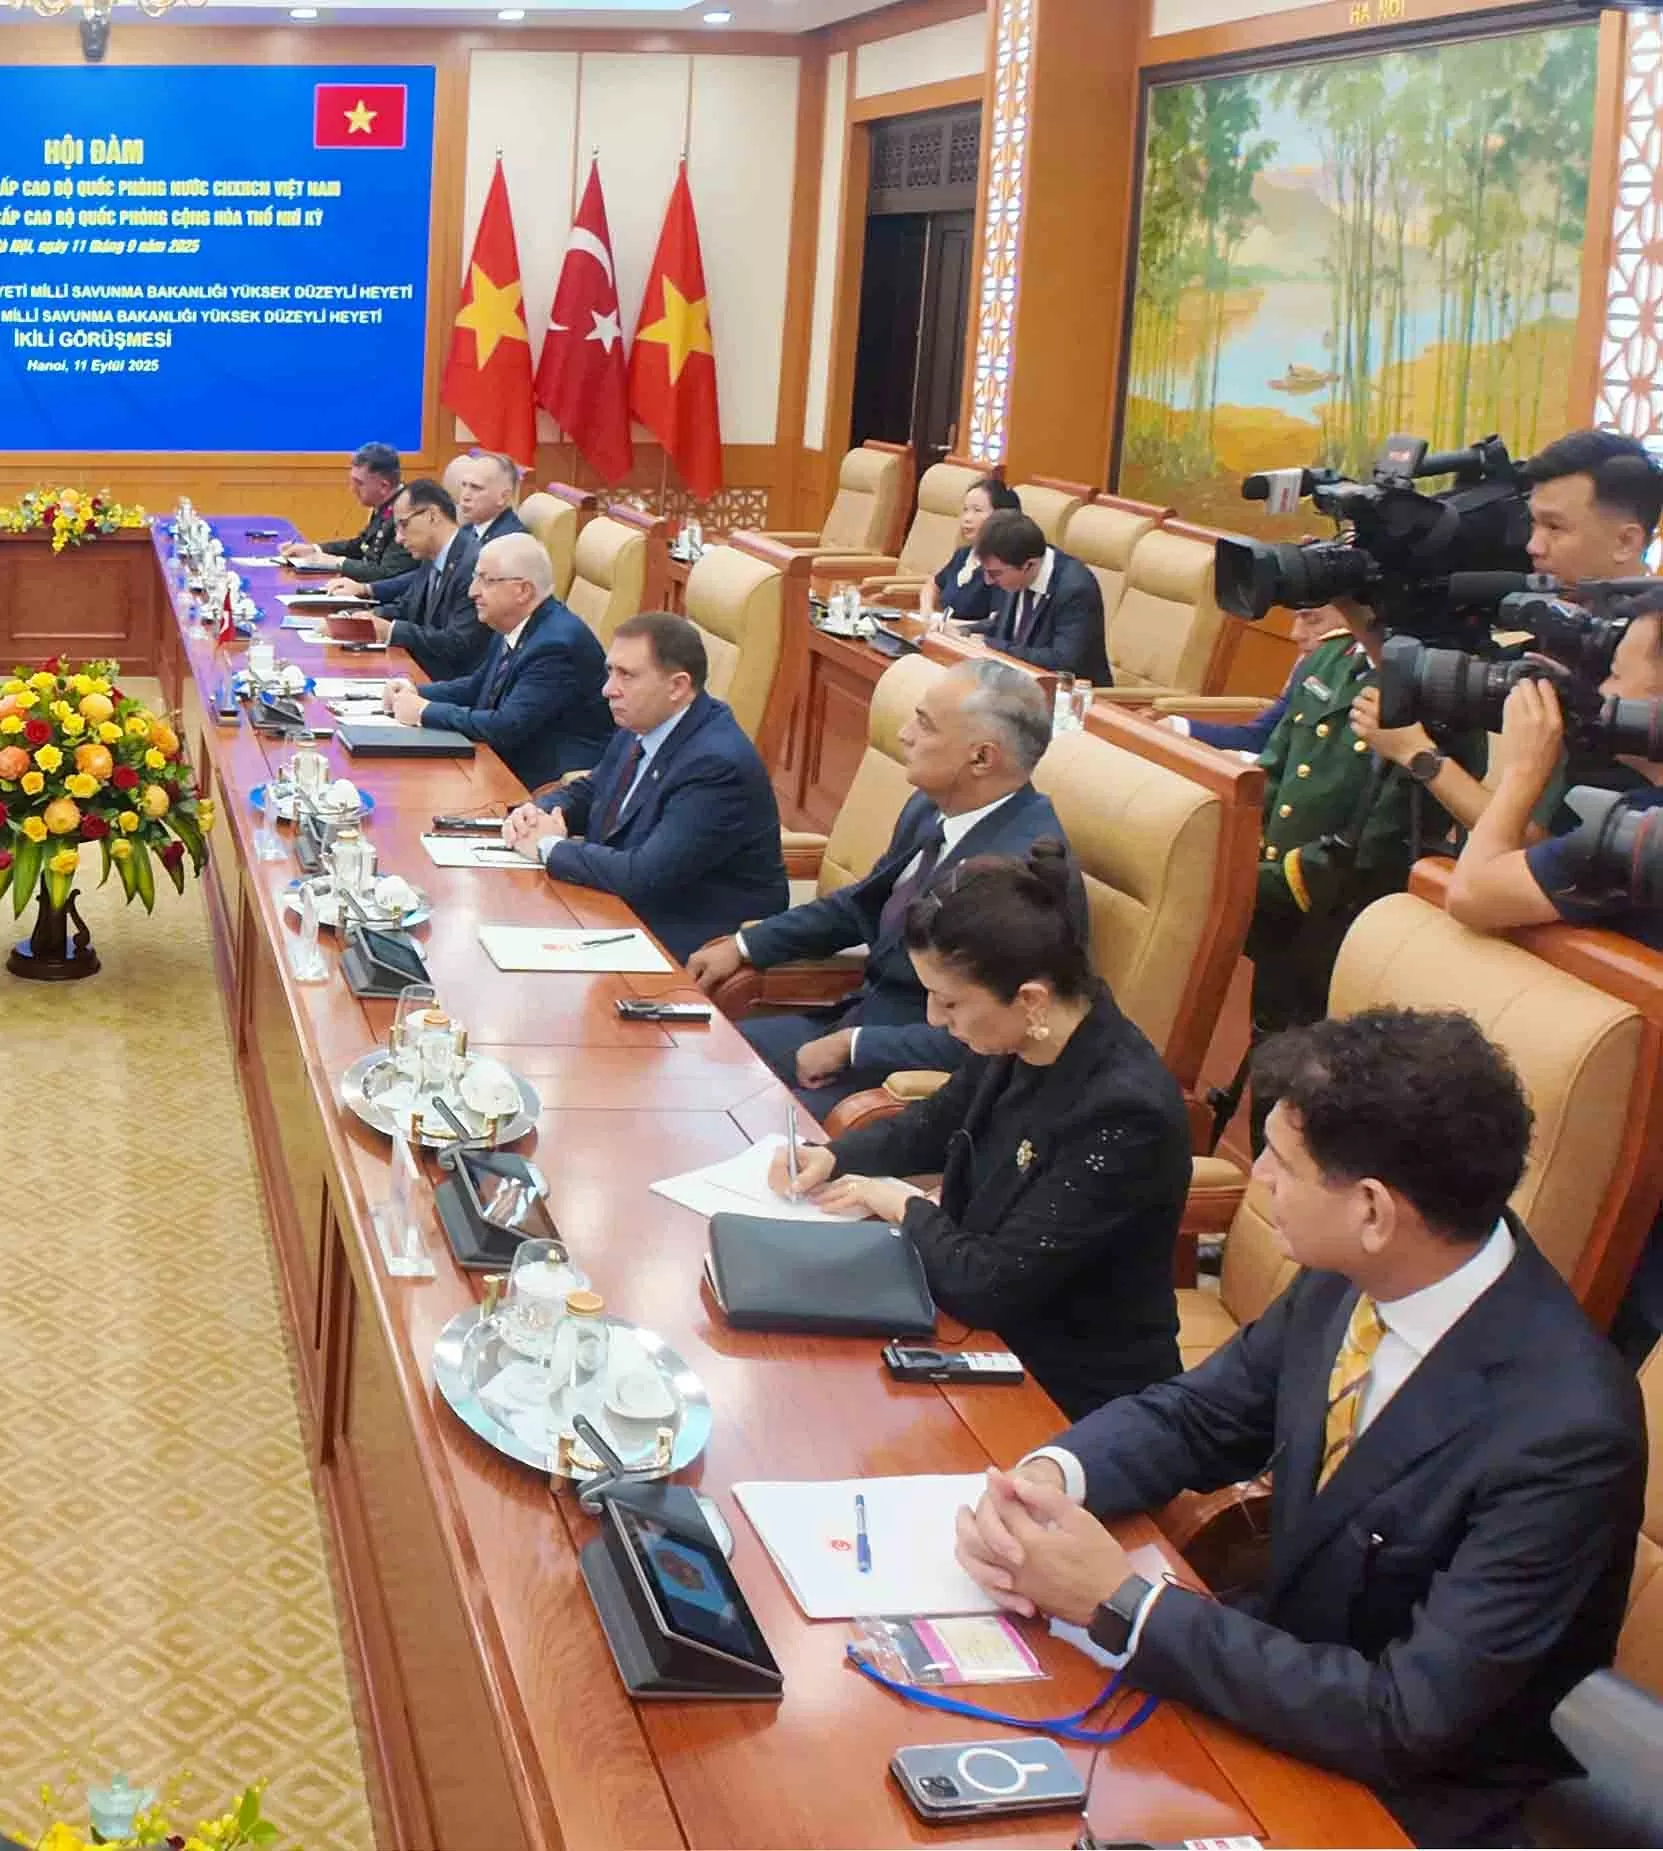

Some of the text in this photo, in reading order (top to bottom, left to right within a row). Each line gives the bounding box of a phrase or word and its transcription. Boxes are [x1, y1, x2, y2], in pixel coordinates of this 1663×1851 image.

[44, 133, 145, 170] HỘI ĐÀM
[22, 179, 51, 197] CAO
[53, 177, 74, 200] BỘ
[76, 176, 115, 198] QUỐC
[273, 178, 305, 200] VIỆT
[307, 180, 342, 197] NAM
[23, 209, 53, 226] CAO
[55, 207, 76, 229] BỘ
[78, 206, 117, 227] QUỐC
[72, 239, 87, 253] 11
[167, 238, 201, 254] 2025
[71, 285, 144, 299] SAVUNMA
[146, 283, 228, 299] BAKANLIĞI
[230, 285, 291, 299] YÜKSEK
[294, 284, 357, 299] DÜZEYLİ
[359, 284, 413, 299] HEYETİ
[42, 309, 114, 323] SAVUNMA
[116, 307, 197, 323] BAKANLIĞI
[200, 309, 261, 324] YÜKSEK
[264, 308, 327, 324] DÜZEYLİ
[329, 308, 382, 324] HEYETİ
[14, 328, 172, 351] İKİLİ GÖRÜŞMESİ
[74, 359, 87, 371] 11
[90, 359, 125, 374] Eylül
[127, 359, 160, 372] 2025
